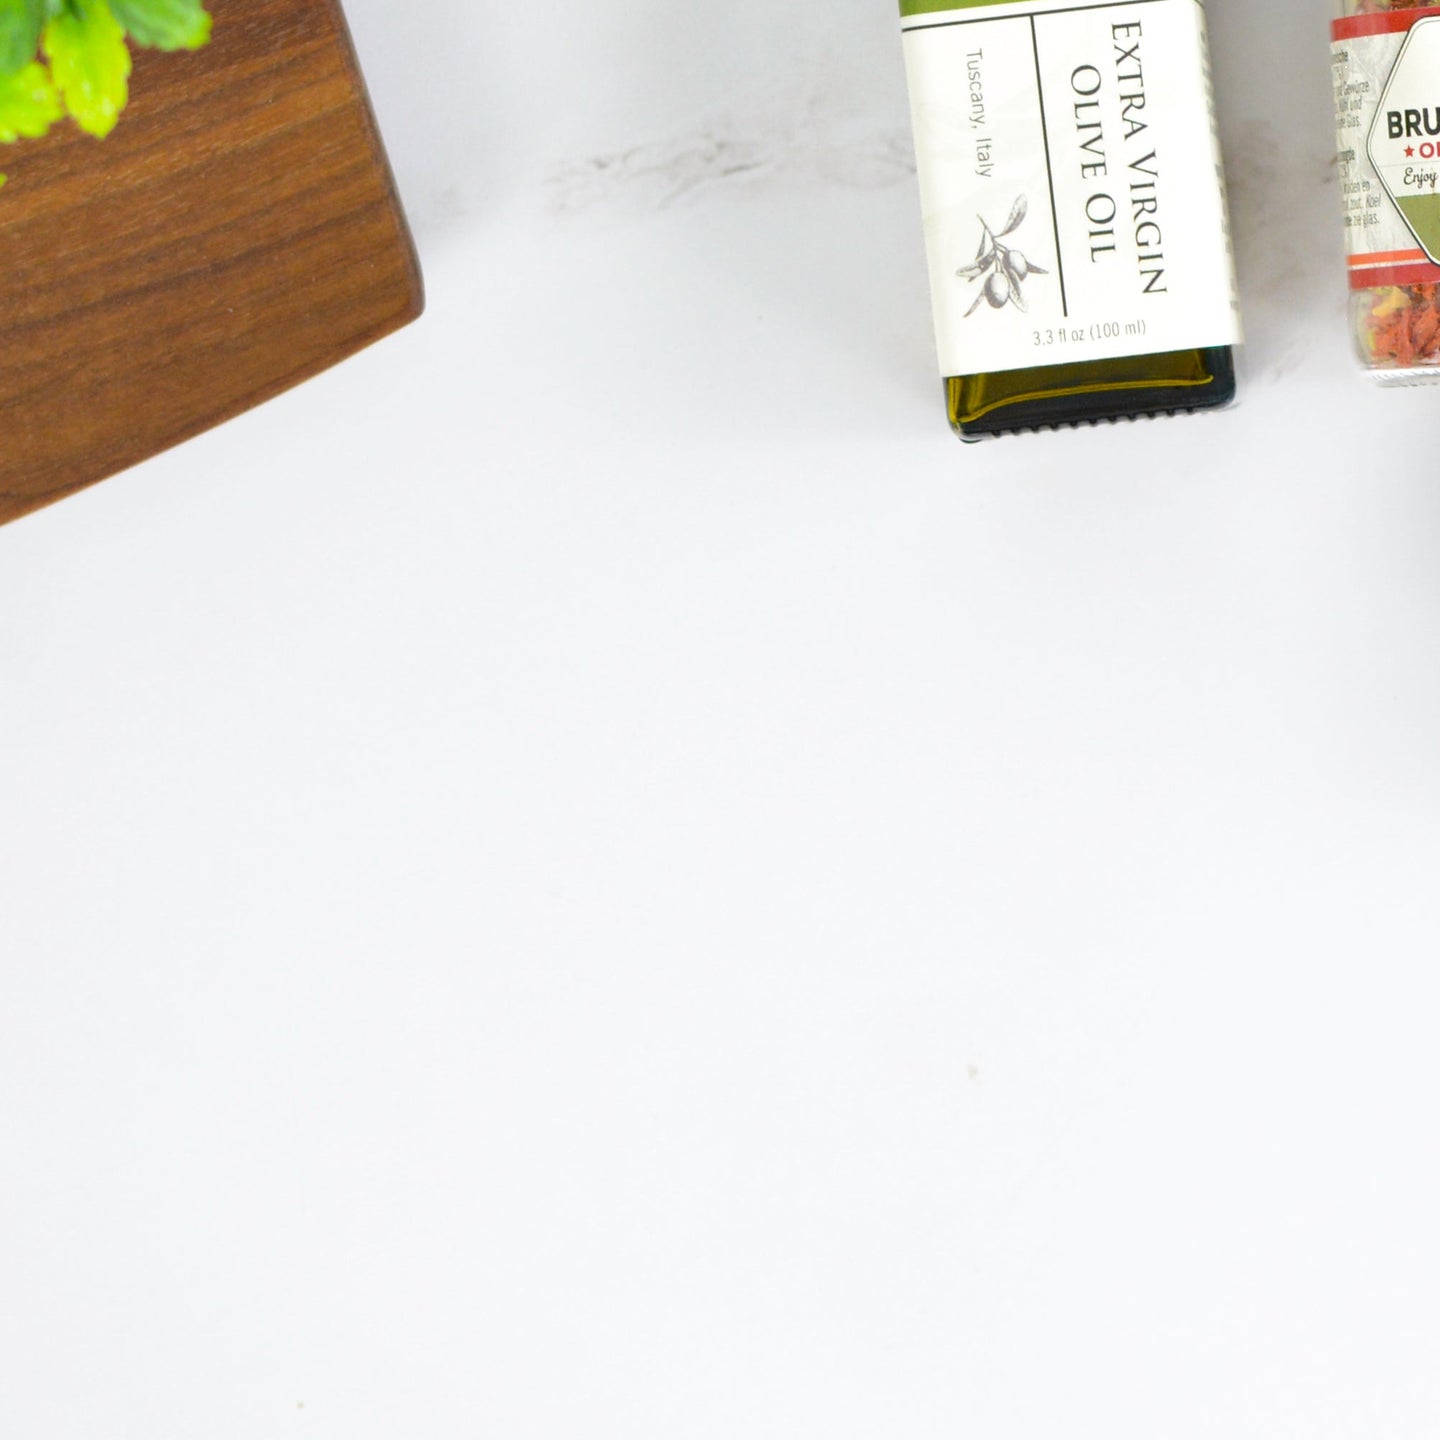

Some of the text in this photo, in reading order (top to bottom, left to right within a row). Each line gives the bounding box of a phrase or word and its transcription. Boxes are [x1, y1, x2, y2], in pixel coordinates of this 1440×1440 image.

[966, 47, 992, 178] Tuscany, Italy
[1071, 64, 1116, 263] OLIVE OIL
[1111, 20, 1167, 294] EXTRA VIRGIN
[1403, 167, 1437, 189] Enjoy
[1033, 319, 1147, 346] 3.3 fl oz (100 ml)
